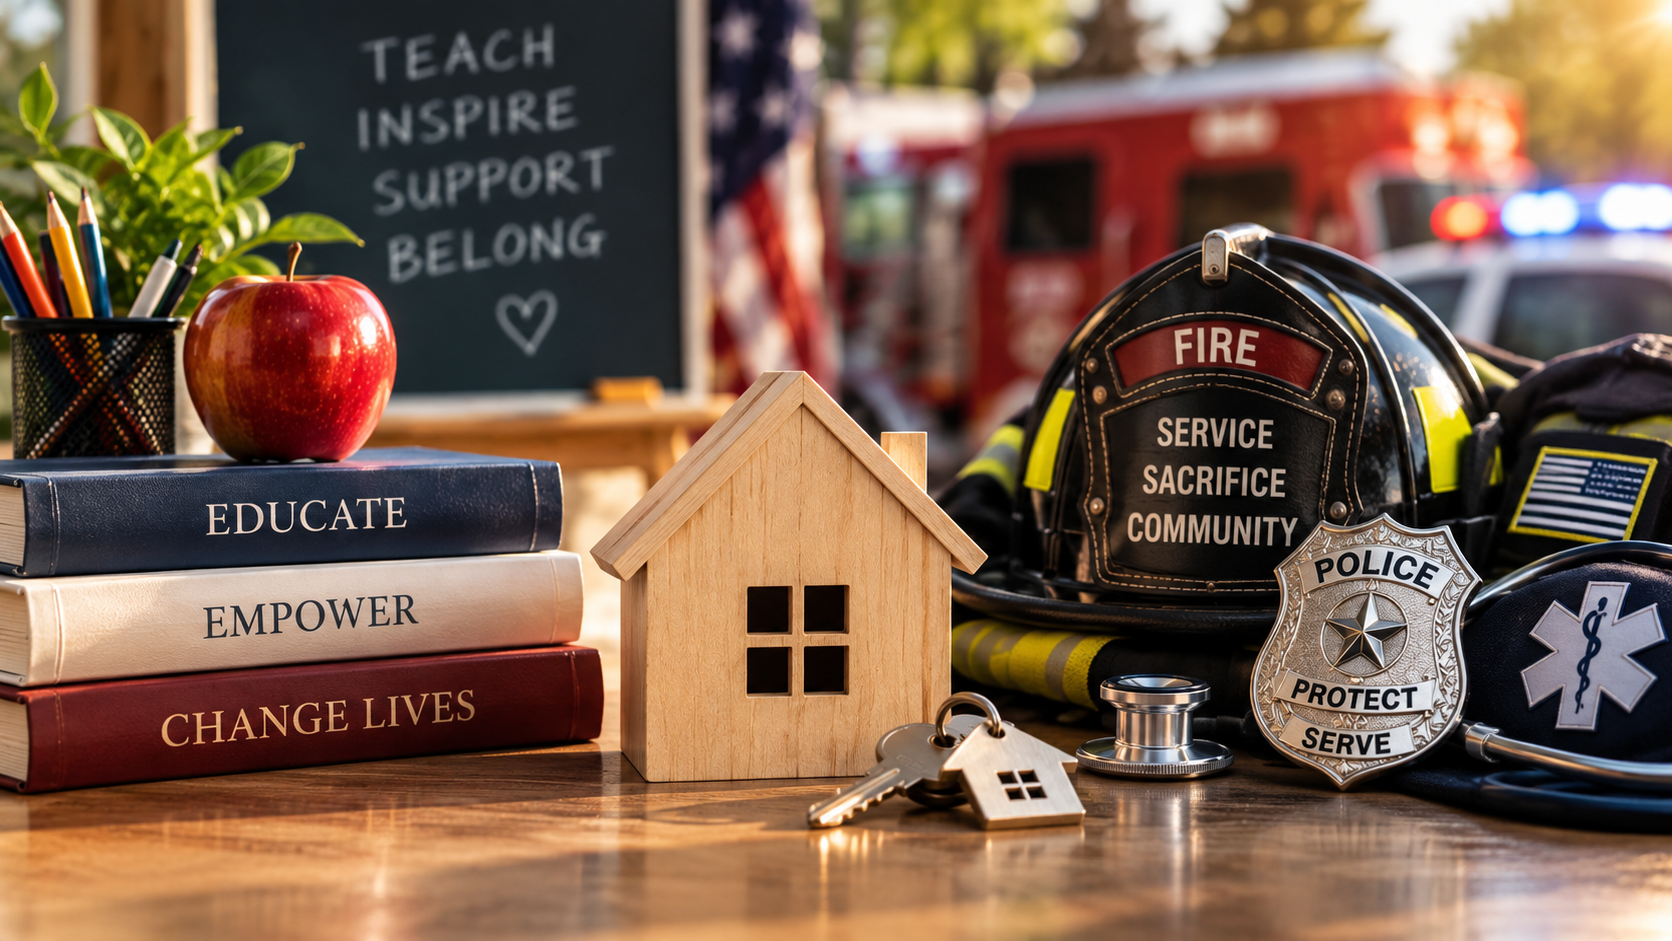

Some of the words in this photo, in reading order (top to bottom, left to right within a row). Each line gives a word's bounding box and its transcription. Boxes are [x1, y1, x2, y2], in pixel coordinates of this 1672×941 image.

[360, 24, 555, 83] TEACH
[358, 86, 577, 150] INSPIRE
[373, 145, 614, 215] SUPPORT
[387, 213, 606, 283] BELONG
[1174, 326, 1260, 367] FIRE
[1157, 417, 1274, 450] SERVICE
[1142, 464, 1287, 498] SACRIFICE
[206, 497, 407, 535] EDUCATE
[1127, 513, 1298, 547] COMMUNITY
[1314, 550, 1440, 589] POLICE
[203, 594, 419, 639] EMPOWER
[1291, 678, 1418, 711] PROTECT
[161, 701, 348, 747] CHANGE
[363, 690, 476, 729] LIVES
[1302, 727, 1391, 755] SERVE
